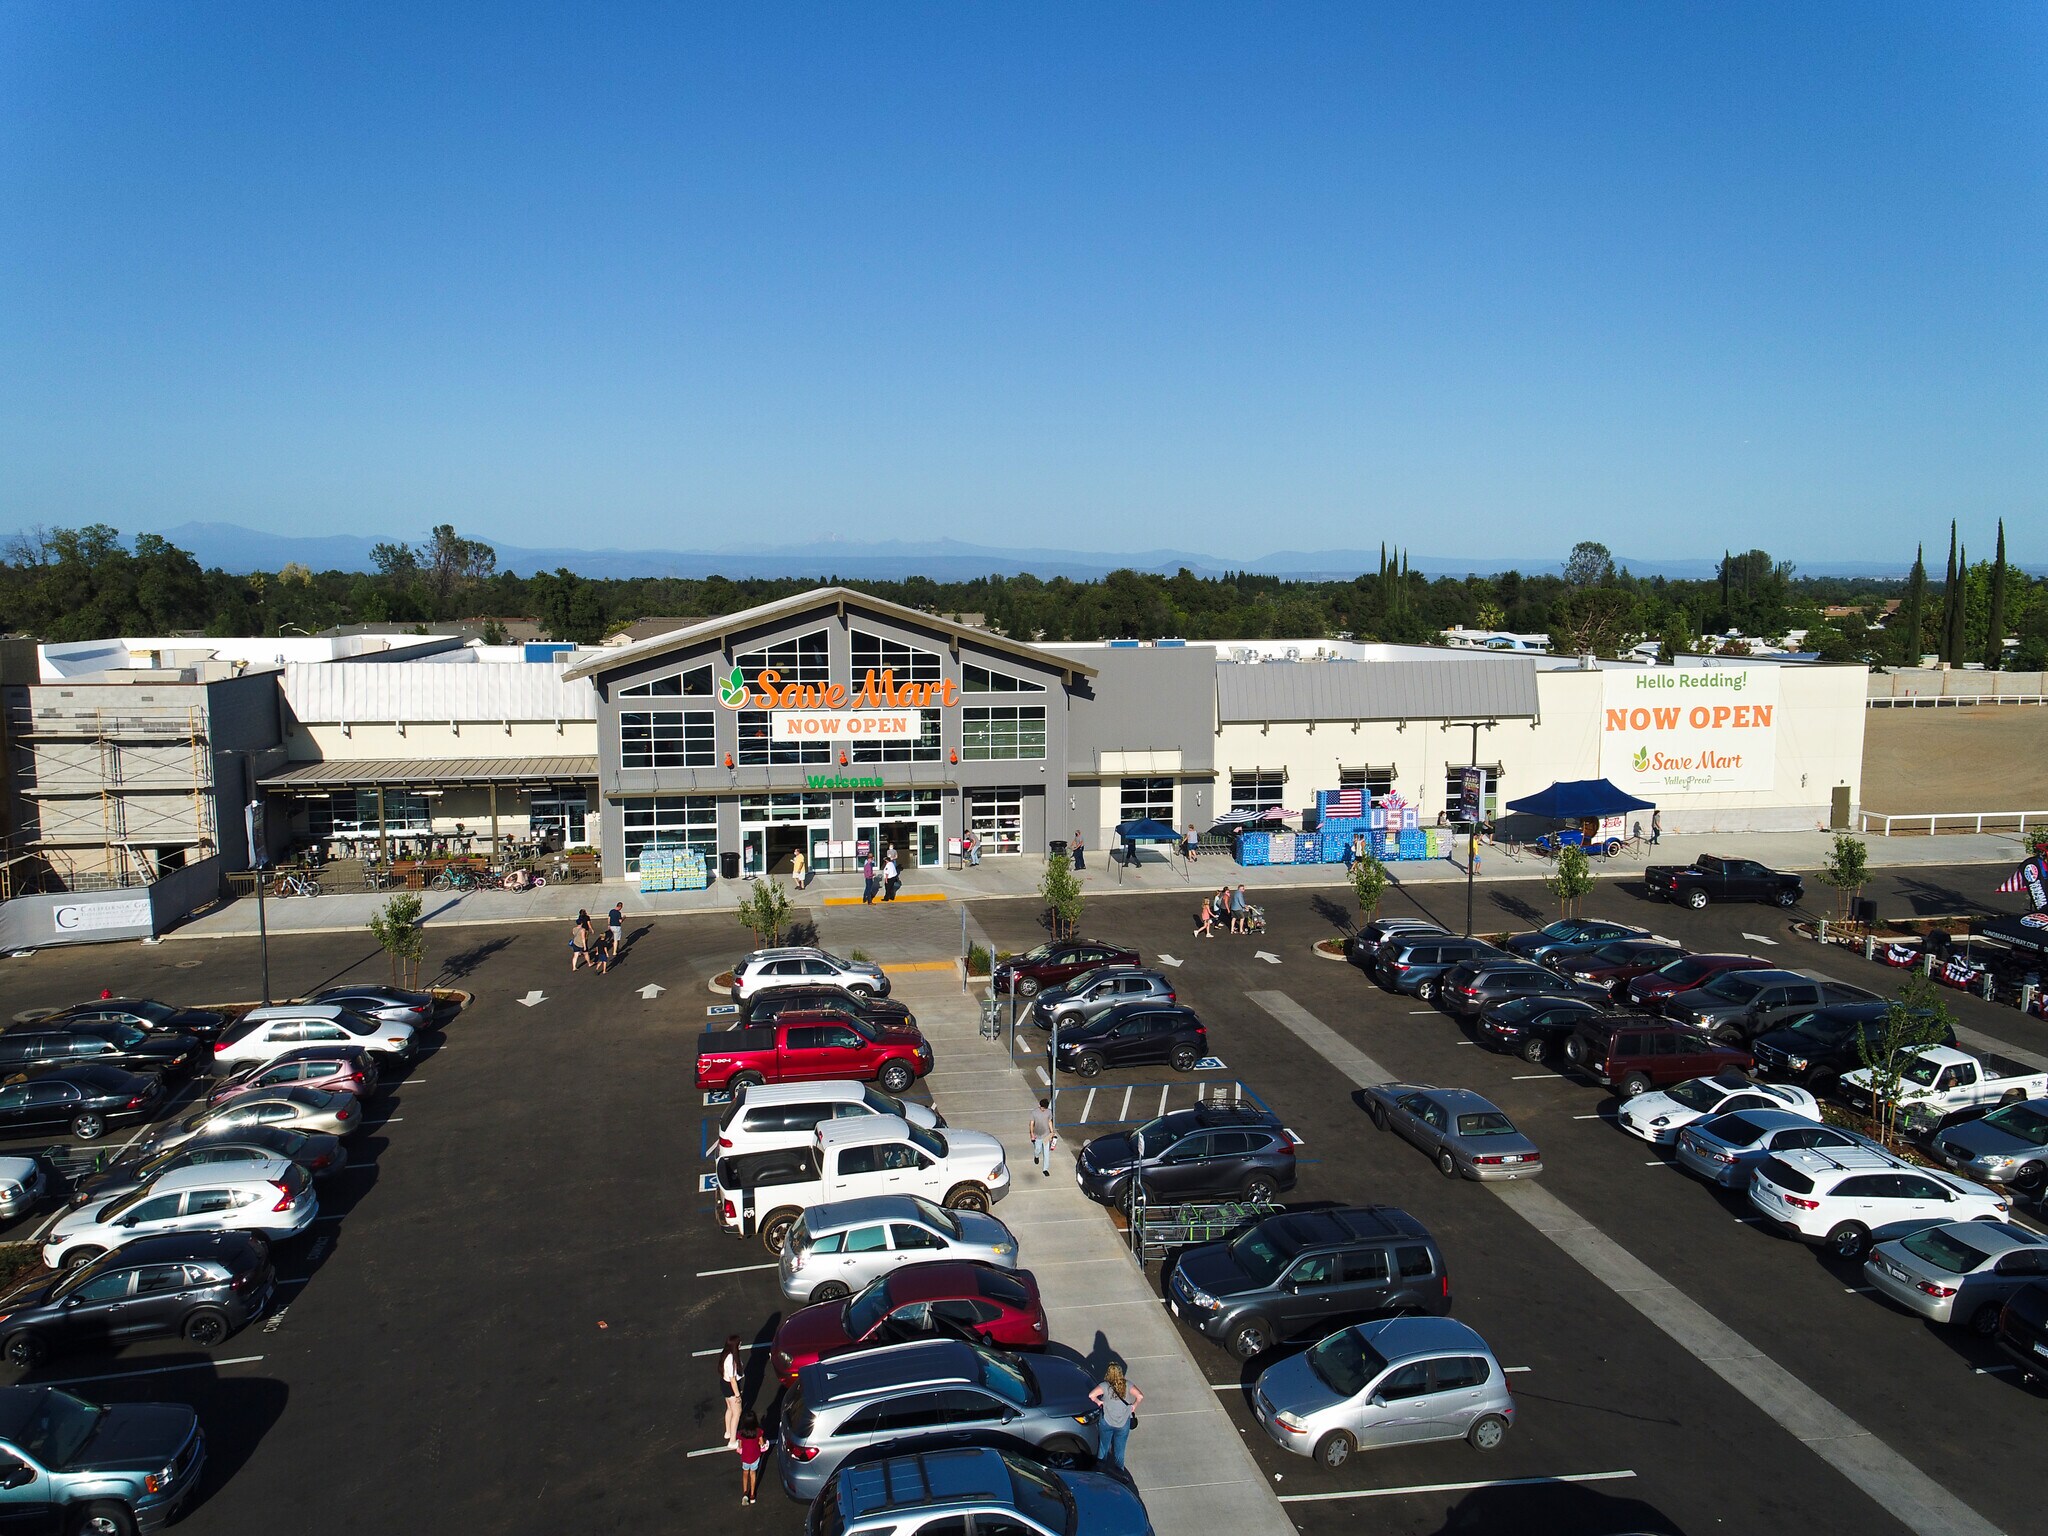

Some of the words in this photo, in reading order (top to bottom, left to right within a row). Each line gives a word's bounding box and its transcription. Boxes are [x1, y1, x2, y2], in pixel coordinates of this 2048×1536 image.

[754, 669, 848, 709] Save
[851, 668, 960, 709] Mart
[1636, 674, 1675, 689] Hello
[1679, 671, 1747, 691] Redding!
[787, 718, 841, 735] NOW
[846, 717, 907, 734] OPEN
[1605, 707, 1681, 732] NOW
[1689, 705, 1774, 729] OPEN
[1652, 751, 1693, 771] Save
[1696, 750, 1743, 770] Mart
[807, 774, 885, 789] Welcome
[1371, 810, 1417, 829] USA
